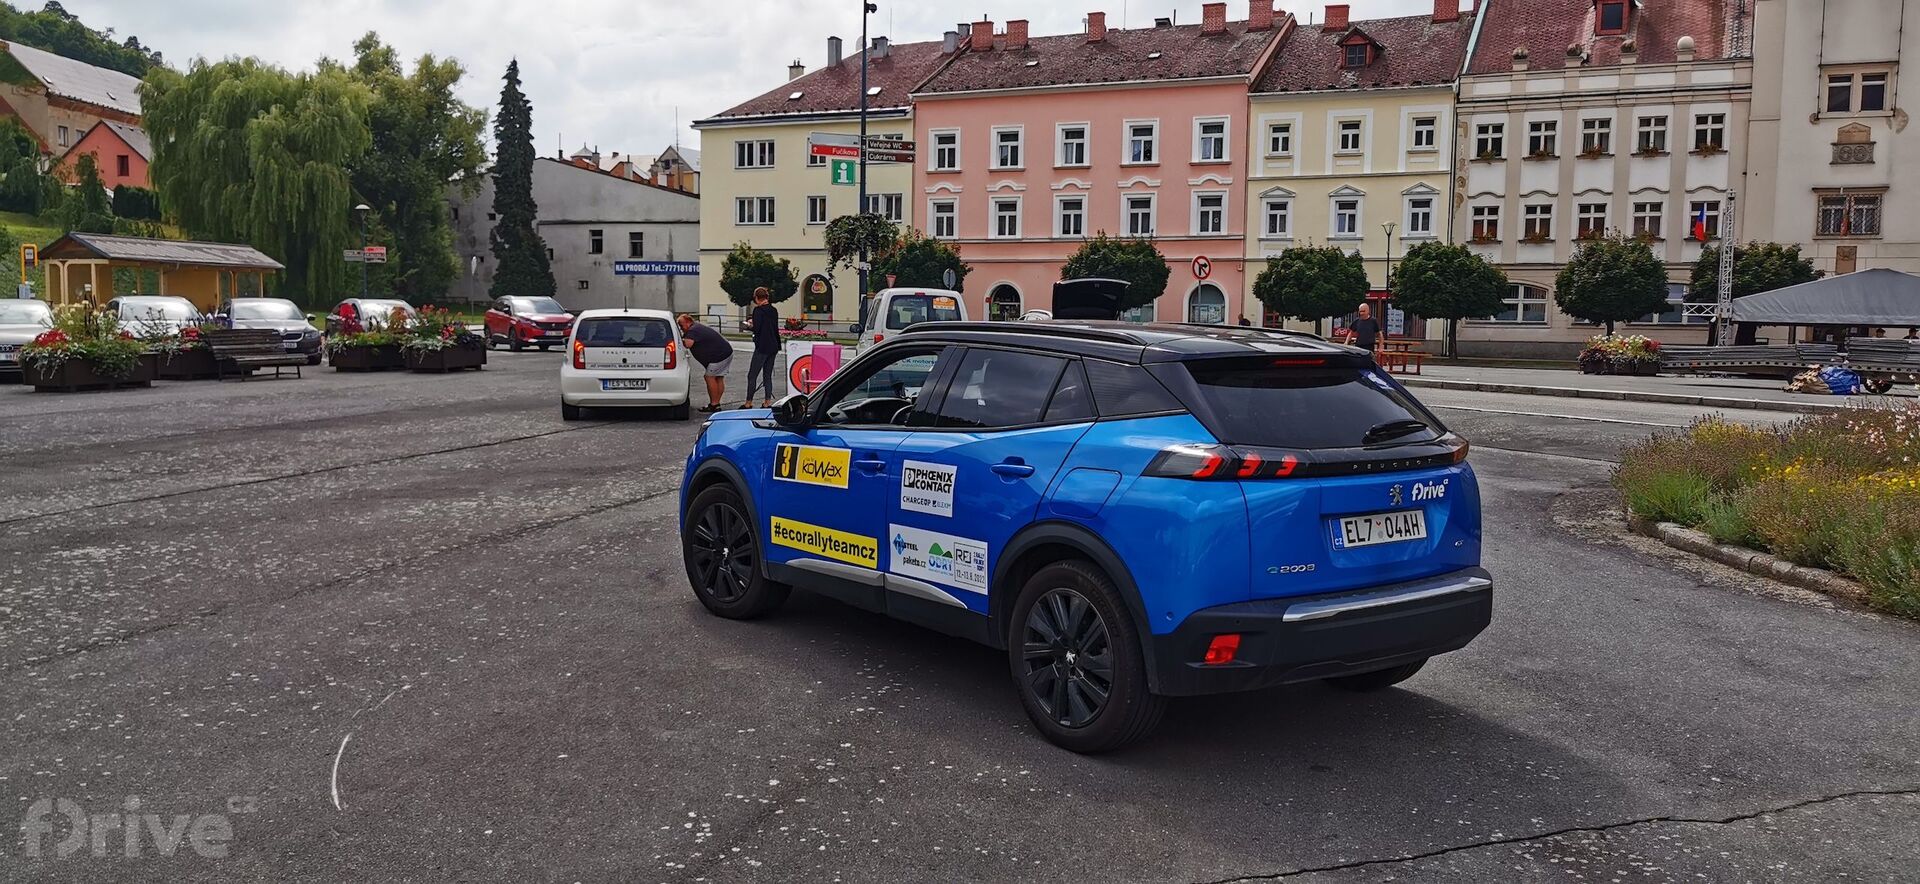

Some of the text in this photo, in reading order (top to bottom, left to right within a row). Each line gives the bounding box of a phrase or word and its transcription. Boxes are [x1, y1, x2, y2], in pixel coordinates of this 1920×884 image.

[869, 141, 891, 150] Veřejné
[868, 153, 896, 161] Cukrárna
[615, 264, 624, 272] NA
[625, 264, 649, 272] PRODEJ
[781, 445, 792, 477] 3
[1352, 458, 1432, 470] PEUGEOT
[915, 479, 952, 494] CONTACT
[1344, 513, 1421, 544] EL7 04AH
[774, 521, 876, 560] #ecorallyteamcz
[1334, 537, 1343, 546] CZ
